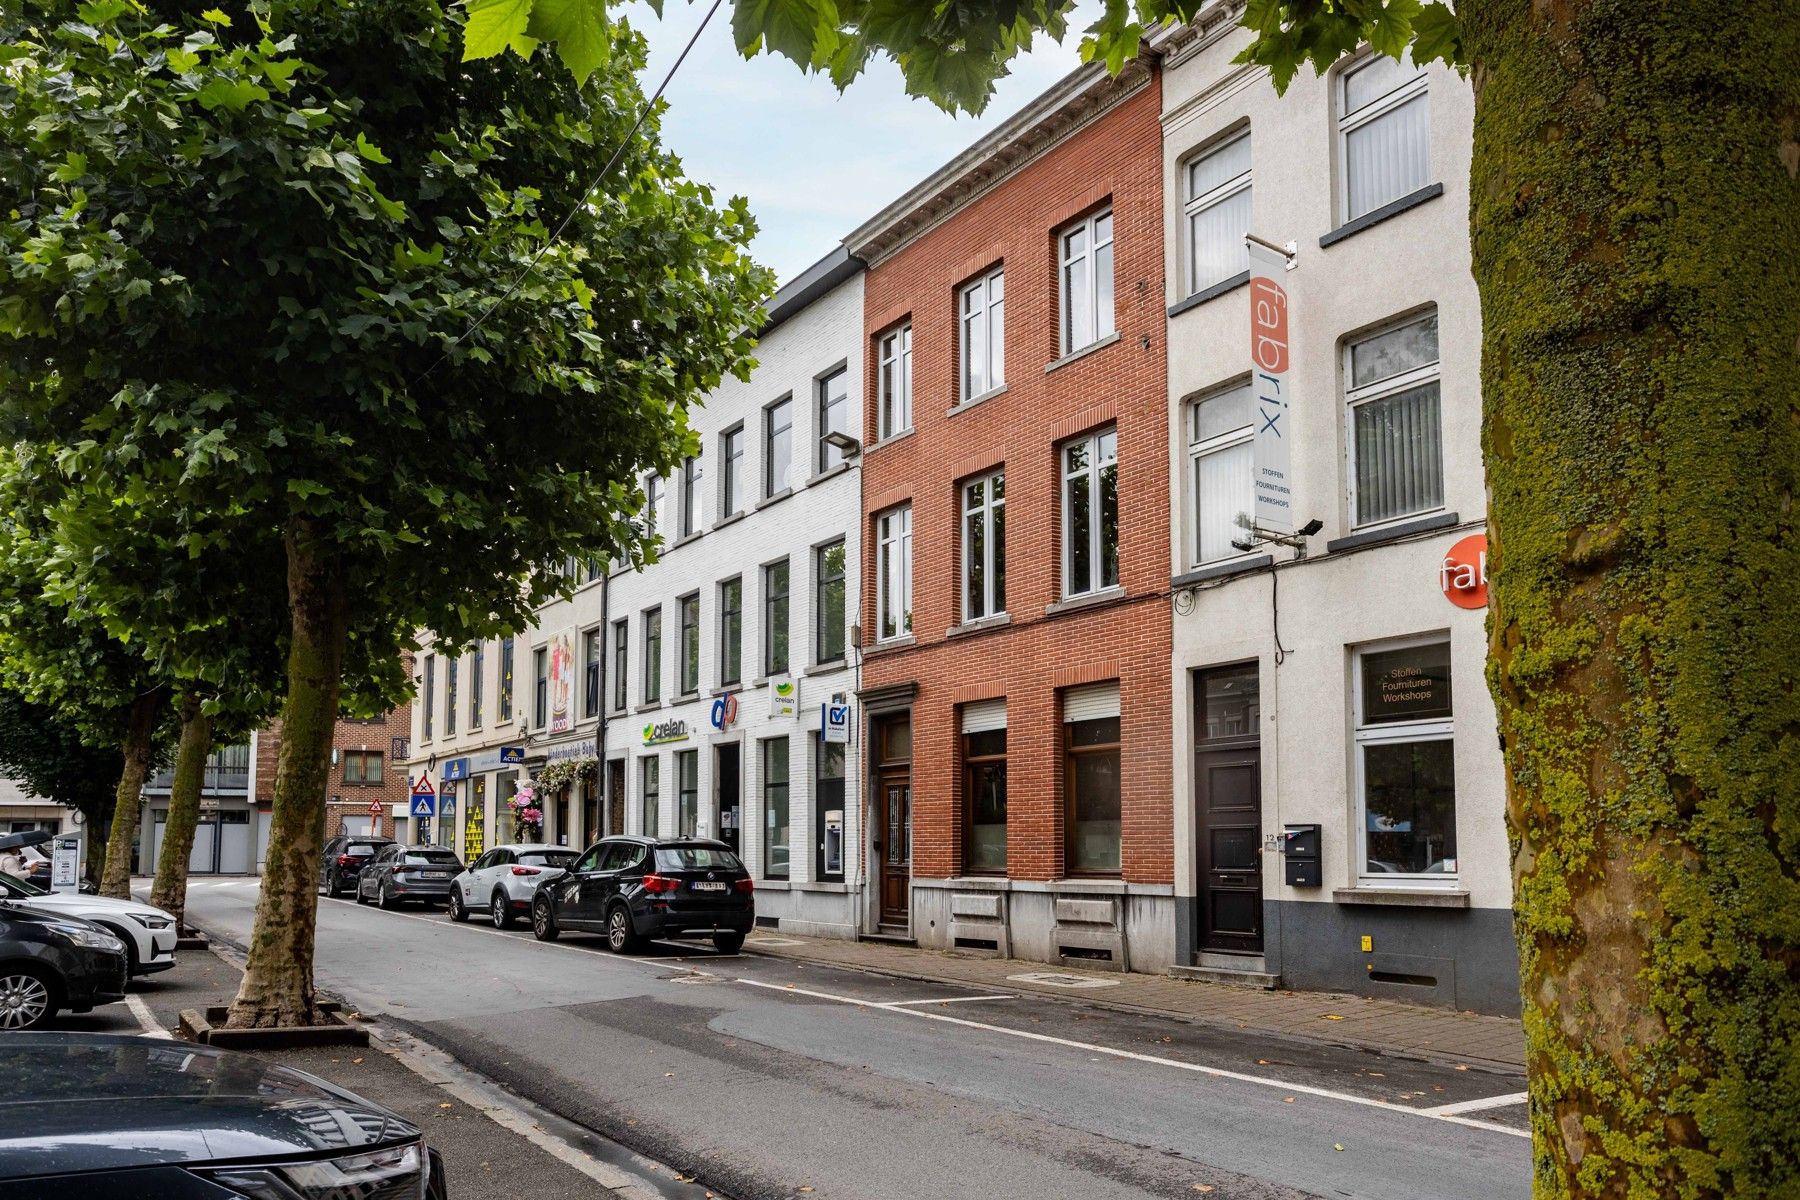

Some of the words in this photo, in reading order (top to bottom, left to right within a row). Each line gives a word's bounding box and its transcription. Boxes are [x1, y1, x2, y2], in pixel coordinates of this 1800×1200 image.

[1256, 283, 1288, 439] fabrix
[1262, 467, 1284, 479] STOFFEN
[1255, 480, 1291, 495] FOURNITUREN
[1257, 495, 1290, 509] WORKSHOPS
[1391, 667, 1422, 678] Stoffen
[1382, 679, 1432, 691] Fournituren
[1383, 691, 1432, 703] Workshops
[653, 718, 685, 738] crelan
